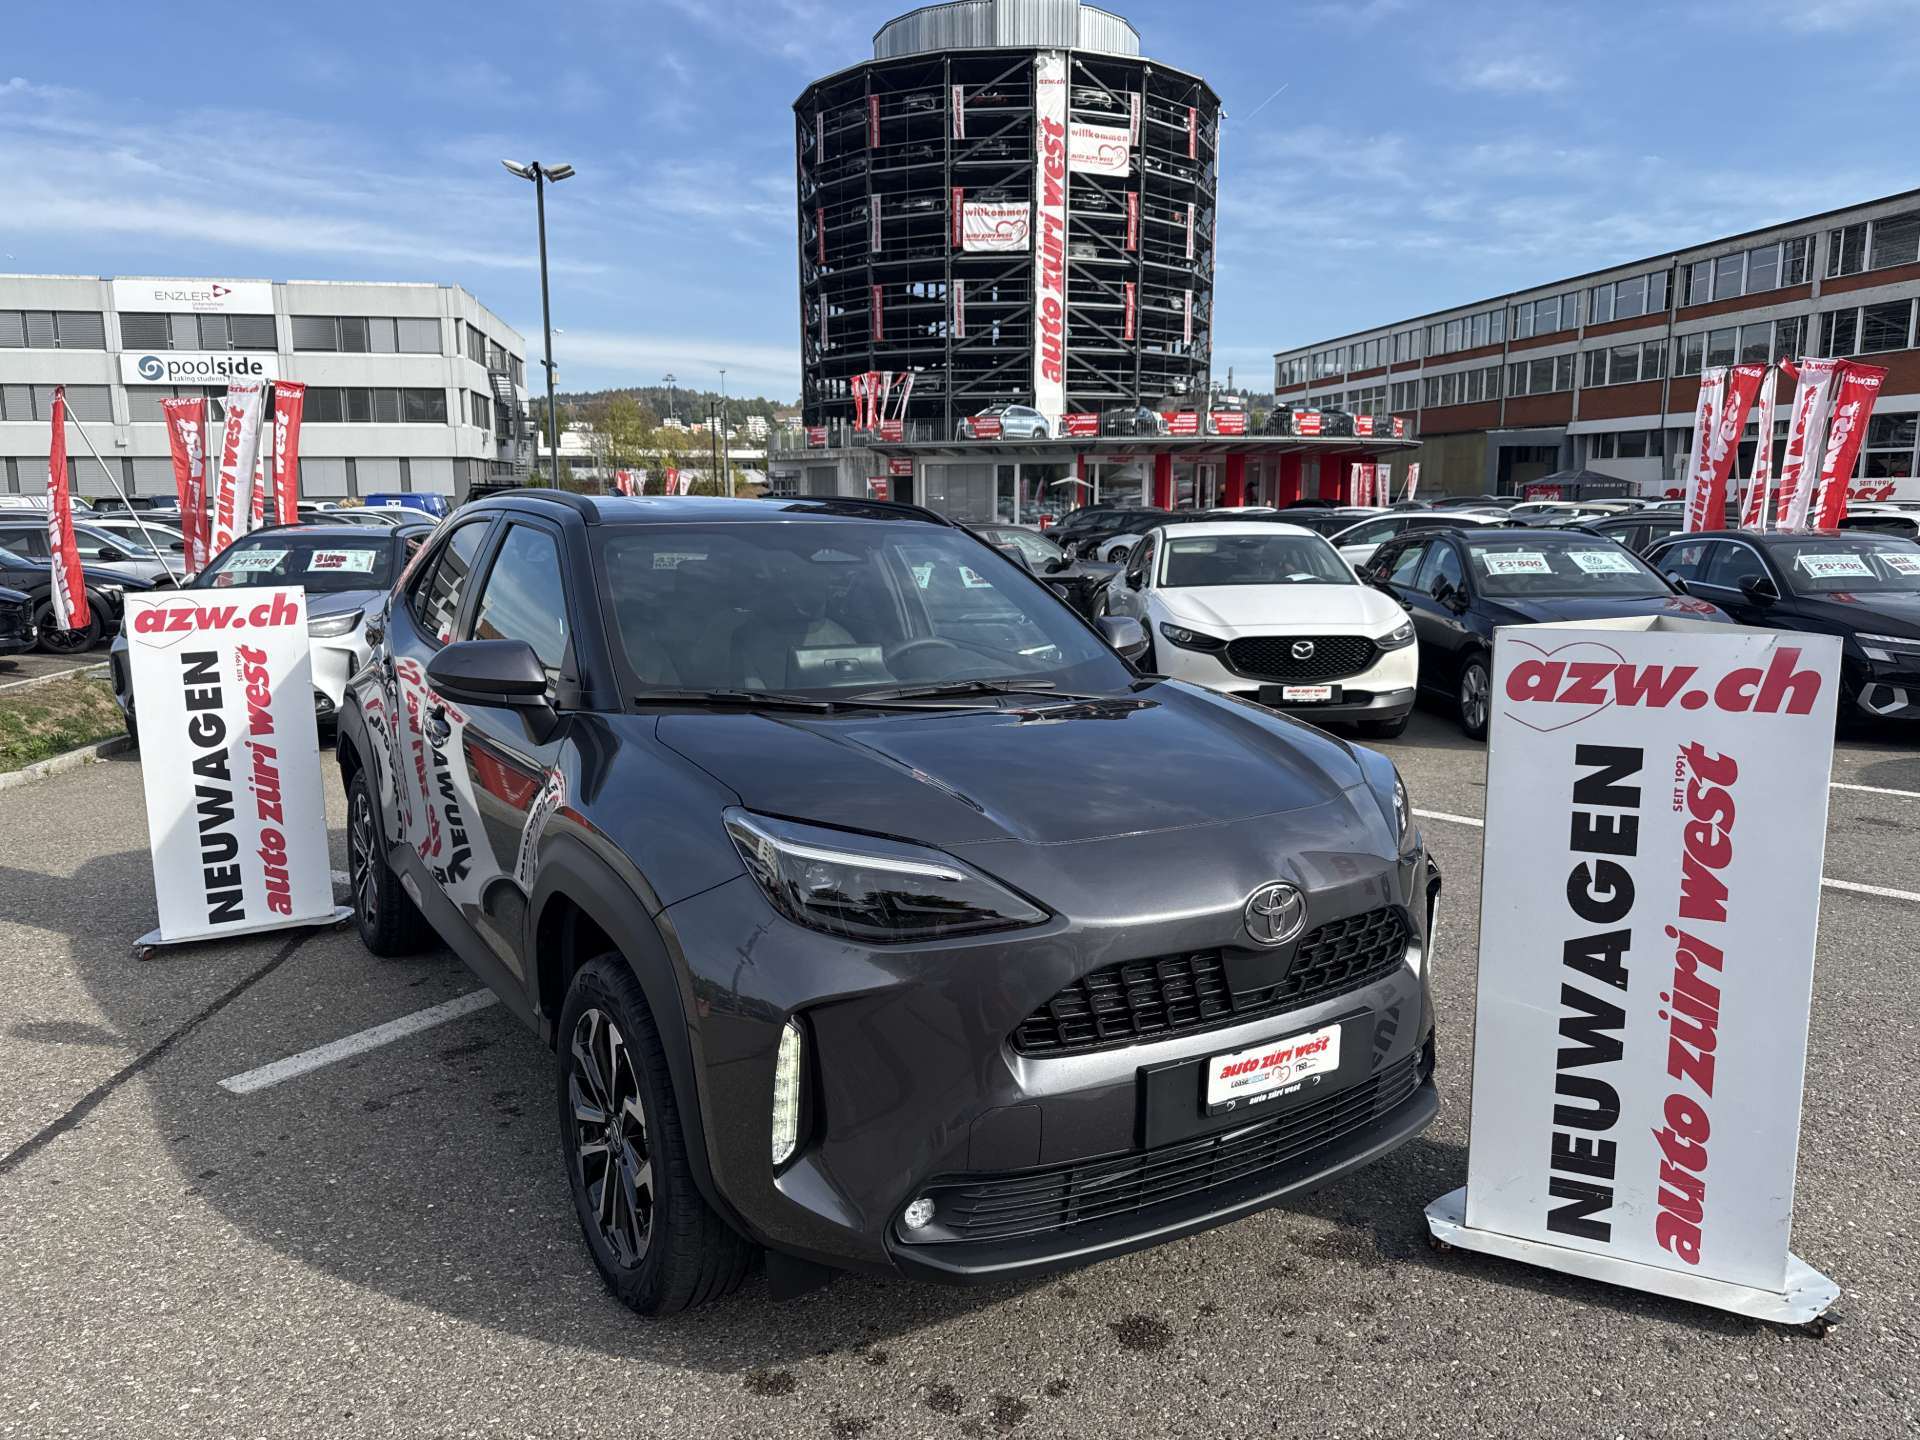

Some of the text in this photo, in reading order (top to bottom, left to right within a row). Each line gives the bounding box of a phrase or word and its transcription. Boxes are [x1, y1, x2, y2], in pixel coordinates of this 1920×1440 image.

[1071, 129, 1128, 142] willkommen
[964, 207, 1029, 217] willkommen
[1038, 115, 1065, 384] auto züri west
[154, 290, 211, 301] ENZLER
[167, 356, 263, 381] poolside
[173, 375, 196, 383] taking
[223, 405, 245, 467] west
[216, 470, 237, 530] züri
[134, 592, 298, 634] azw.ch
[1504, 647, 1822, 717] azw.ch
[180, 650, 246, 925] NEUWAGEN
[235, 644, 293, 917] auto züri west
[1672, 755, 1687, 813] SEIT 1991
[1546, 743, 1645, 1244] NEUWAGEN
[1653, 741, 1739, 1266] auto züri west
[1219, 1036, 1330, 1080] auto züri west
[1249, 1094, 1267, 1105] auto
[1284, 1083, 1302, 1096] west
